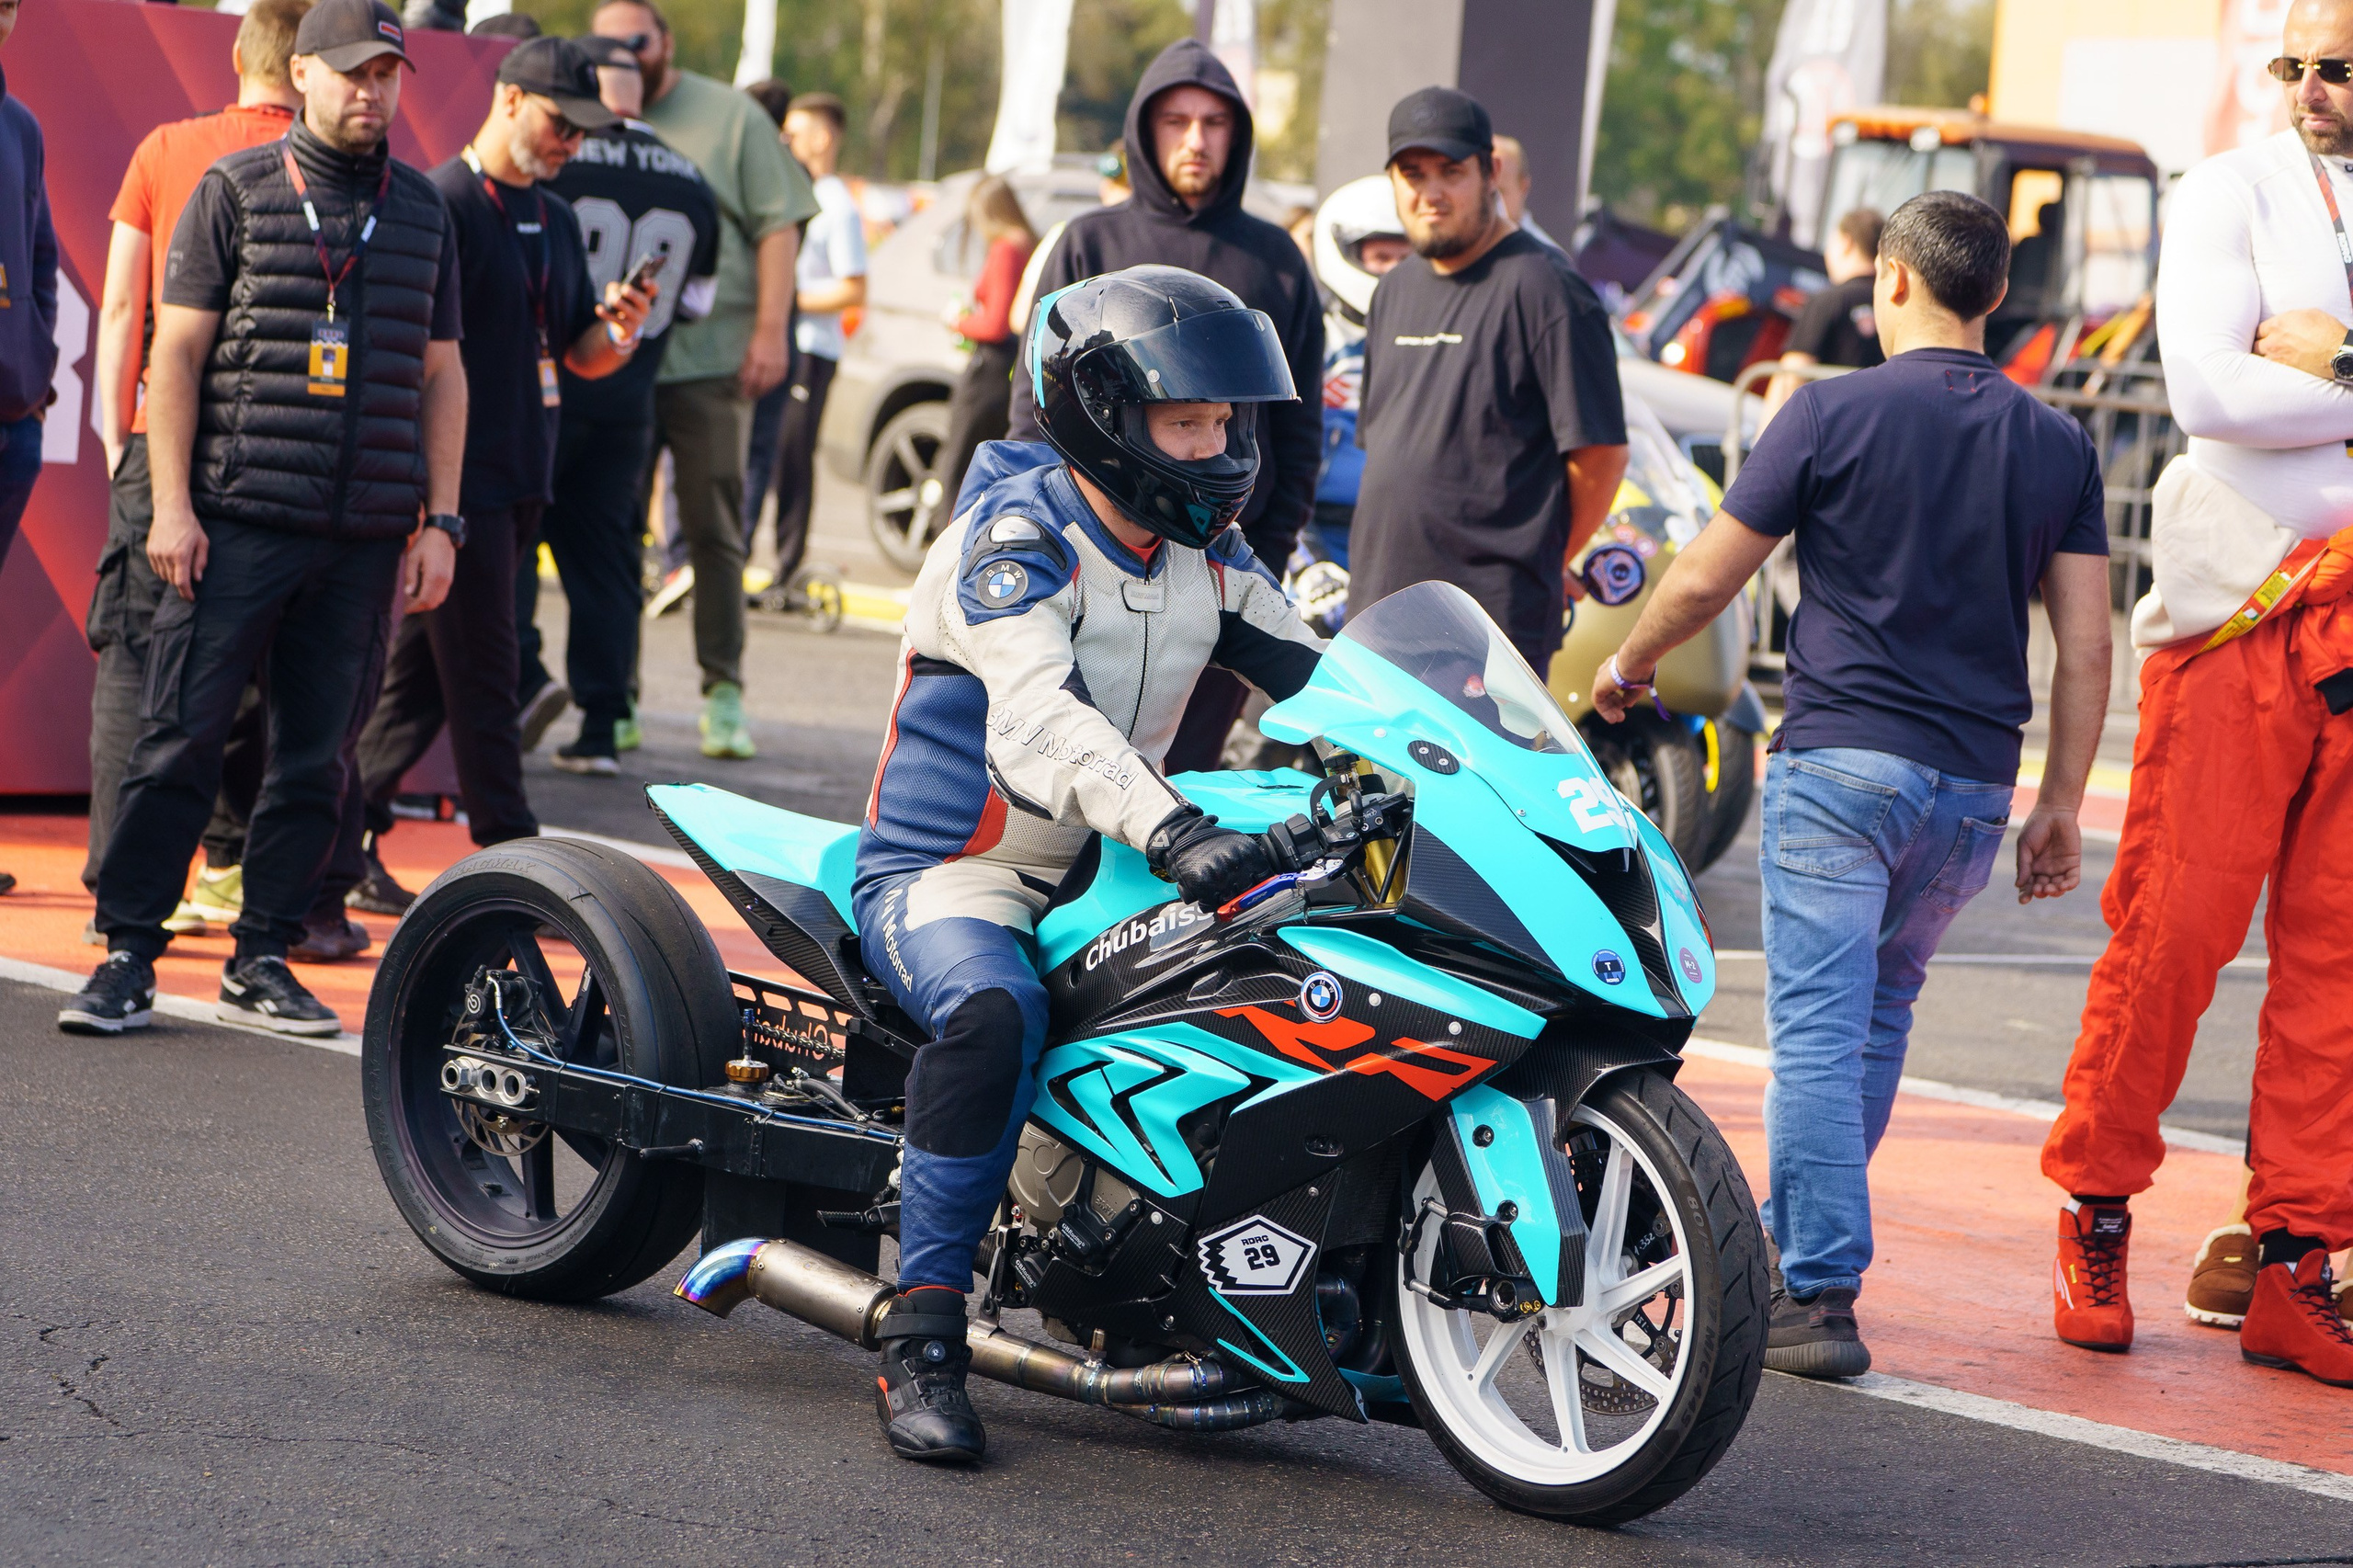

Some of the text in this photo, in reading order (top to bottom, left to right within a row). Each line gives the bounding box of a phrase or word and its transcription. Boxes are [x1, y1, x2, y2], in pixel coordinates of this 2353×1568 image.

[985, 706, 1139, 791] BMW Motorrad
[882, 913, 914, 994] Motorrad
[1240, 1234, 1269, 1246] RDRC
[1244, 1244, 1281, 1271] 29
